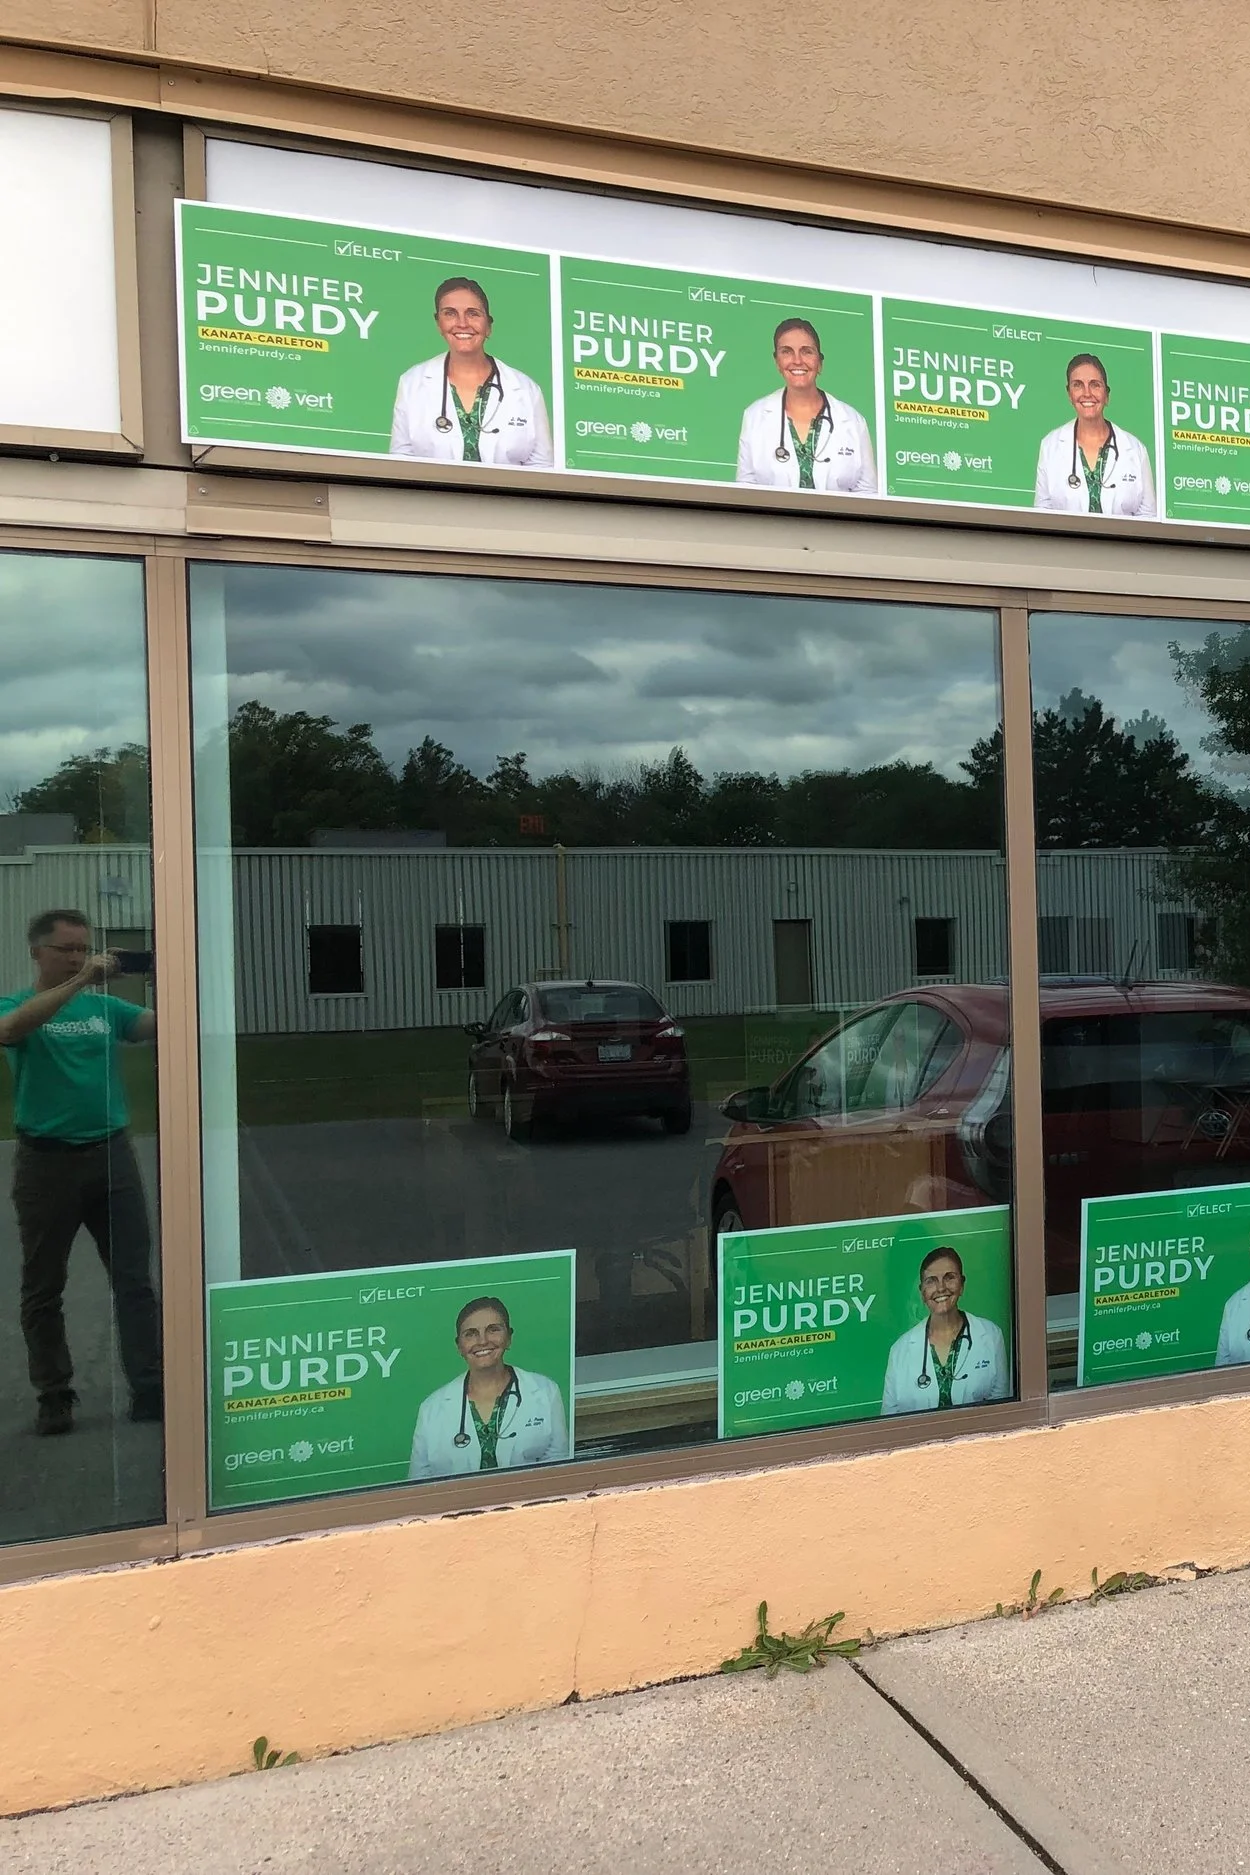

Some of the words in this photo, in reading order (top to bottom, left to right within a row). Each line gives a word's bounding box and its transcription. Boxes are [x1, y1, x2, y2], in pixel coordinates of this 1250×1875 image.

[353, 245, 402, 261] ELECT
[197, 263, 362, 303] JENNIFER
[704, 290, 745, 304] ELECT
[196, 289, 378, 339] PURDY
[573, 310, 712, 344] JENNIFER
[1006, 328, 1042, 341] ELECT
[201, 328, 324, 348] KANATA-CARLETON
[198, 342, 302, 360] JenniferPurdy.ca
[573, 334, 726, 377] PURDY
[893, 347, 1013, 378] JENNIFER
[577, 369, 679, 386] KANATA-CARLETON
[199, 384, 260, 401] green
[295, 393, 333, 409] vert
[574, 382, 661, 397] JenniferPurdy.ca
[893, 370, 1025, 409] PURDY
[896, 402, 985, 418] KANATA-CARLETON
[575, 420, 626, 436] green
[655, 427, 687, 441] vert
[894, 414, 970, 428] JenniferPurdy.ca
[1172, 442, 1238, 455] JenniferPurdy.ca
[895, 450, 939, 465] green
[964, 456, 992, 469] vert
[1173, 476, 1212, 490] green
[1199, 1203, 1232, 1214] ELECT
[856, 1237, 895, 1249] ELECT
[1095, 1236, 1204, 1263] JENNIFER
[1094, 1255, 1214, 1292] PURDY
[377, 1286, 425, 1300] ELECT
[734, 1273, 863, 1305] JENNIFER
[1096, 1287, 1176, 1304] KANATA-CARLETON
[733, 1294, 875, 1337] PURDY
[1093, 1303, 1161, 1315] JenniferPurdy.ca
[224, 1326, 385, 1361] JENNIFER
[736, 1331, 832, 1351] KANATA-CARLETON
[1092, 1337, 1132, 1355] green
[1154, 1328, 1180, 1343] vert
[734, 1348, 814, 1363] JenniferPurdy.ca
[223, 1348, 401, 1396] PURDY
[227, 1388, 346, 1410] KANATA-CARLETON
[734, 1386, 781, 1407] green
[808, 1376, 837, 1392] vert
[224, 1406, 325, 1423] JenniferPurdy.ca
[224, 1448, 283, 1470] green
[317, 1435, 354, 1453] vert
